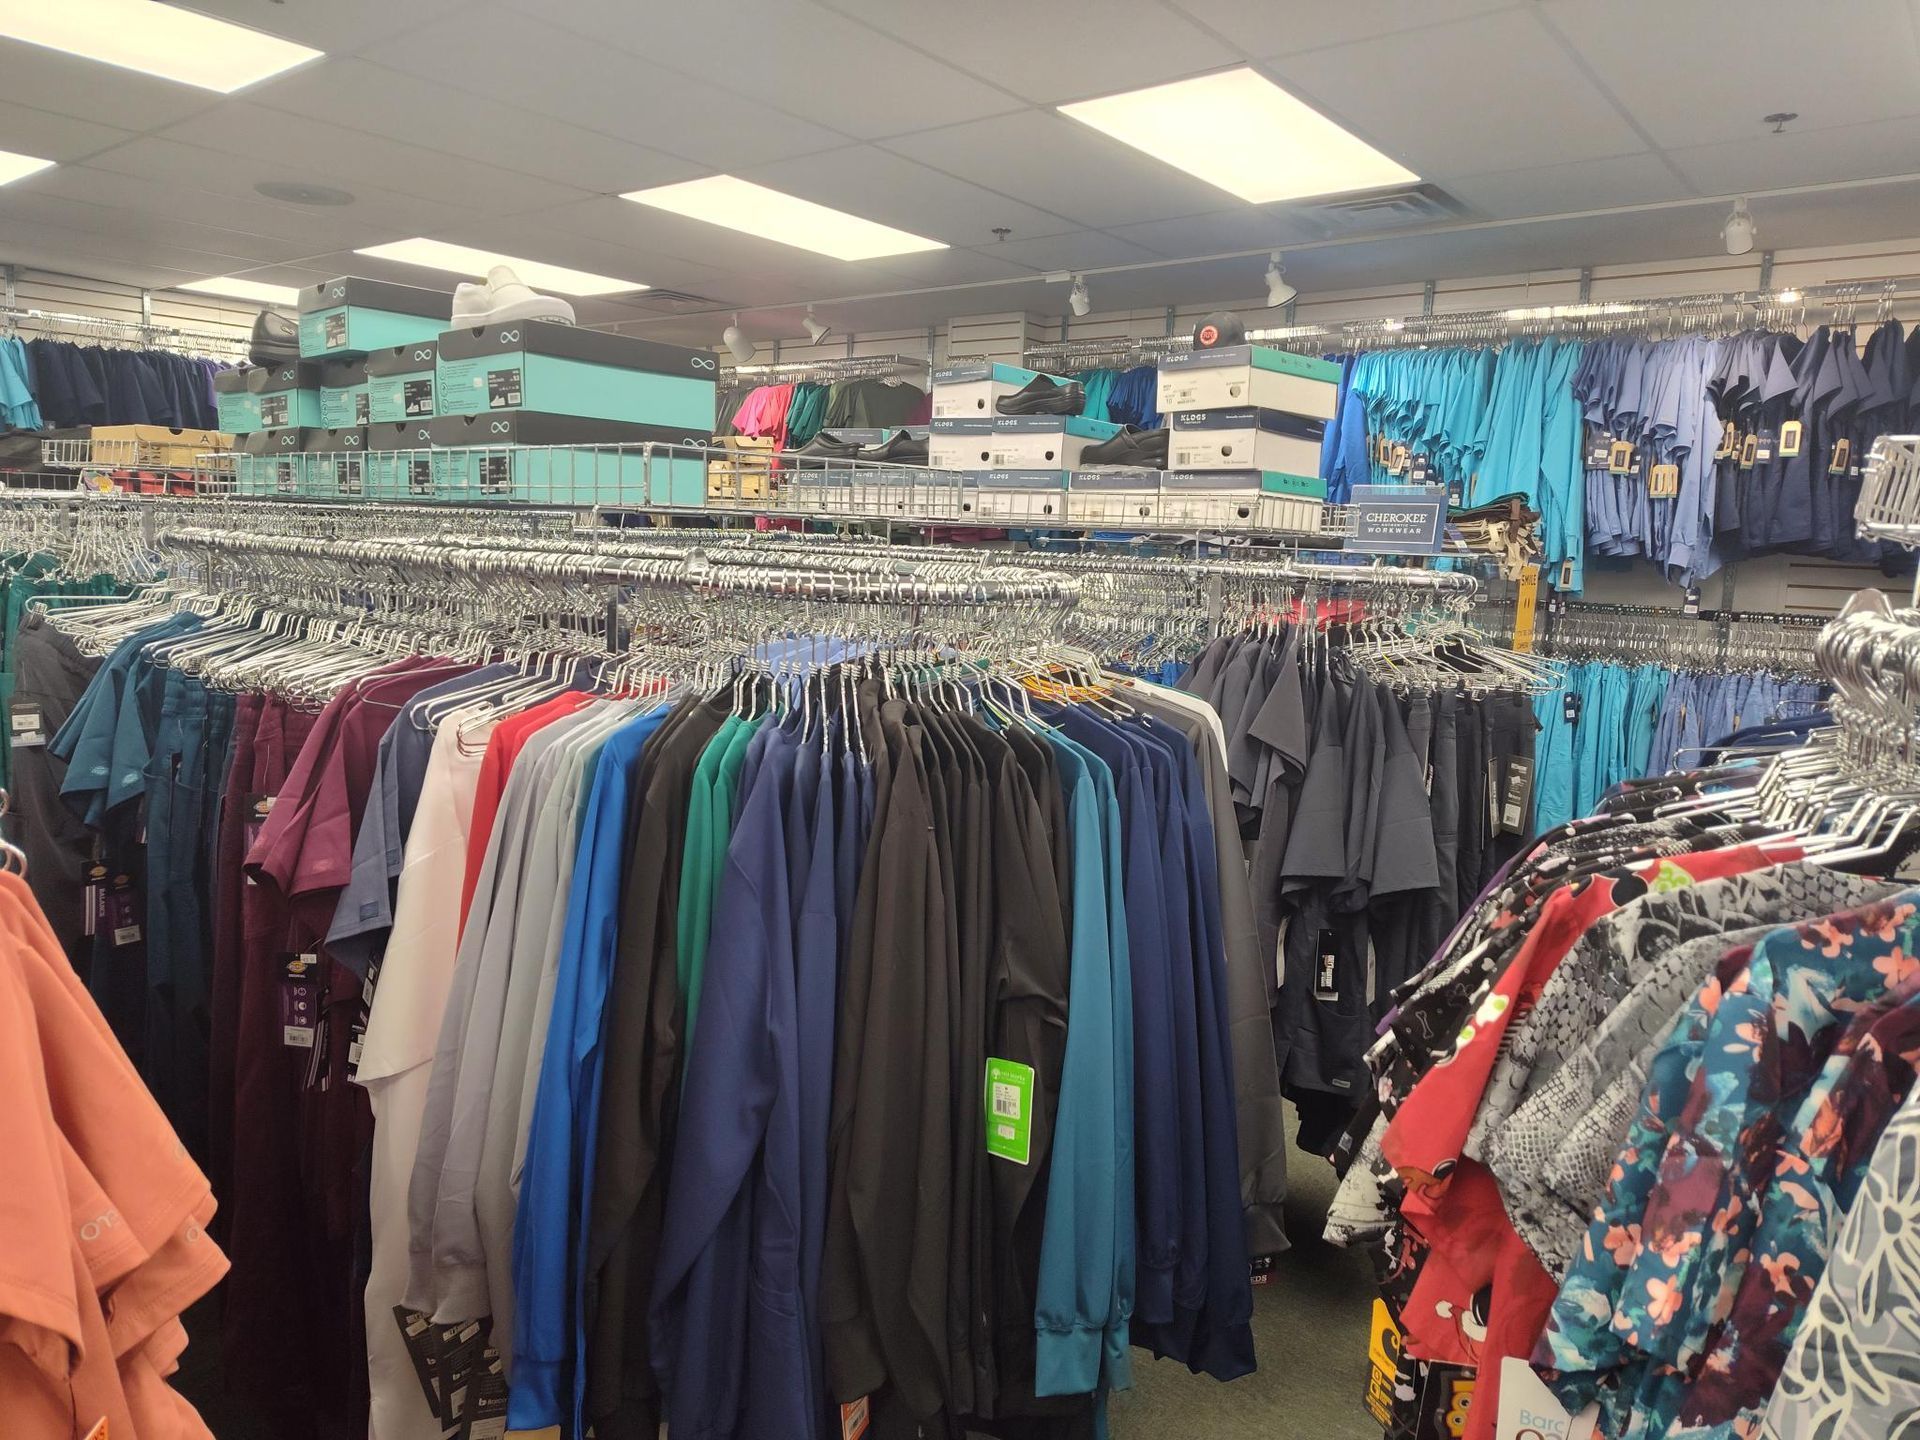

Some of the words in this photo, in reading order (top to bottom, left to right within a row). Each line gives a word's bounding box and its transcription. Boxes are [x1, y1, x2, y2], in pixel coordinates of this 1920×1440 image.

[1166, 354, 1190, 363] KLOGS
[1180, 413, 1207, 422] KLOGS
[997, 419, 1018, 427] KLOGS
[989, 473, 1009, 481] KLOGS
[1170, 473, 1195, 481] KLOGS
[1366, 513, 1428, 523] CHEROKEE
